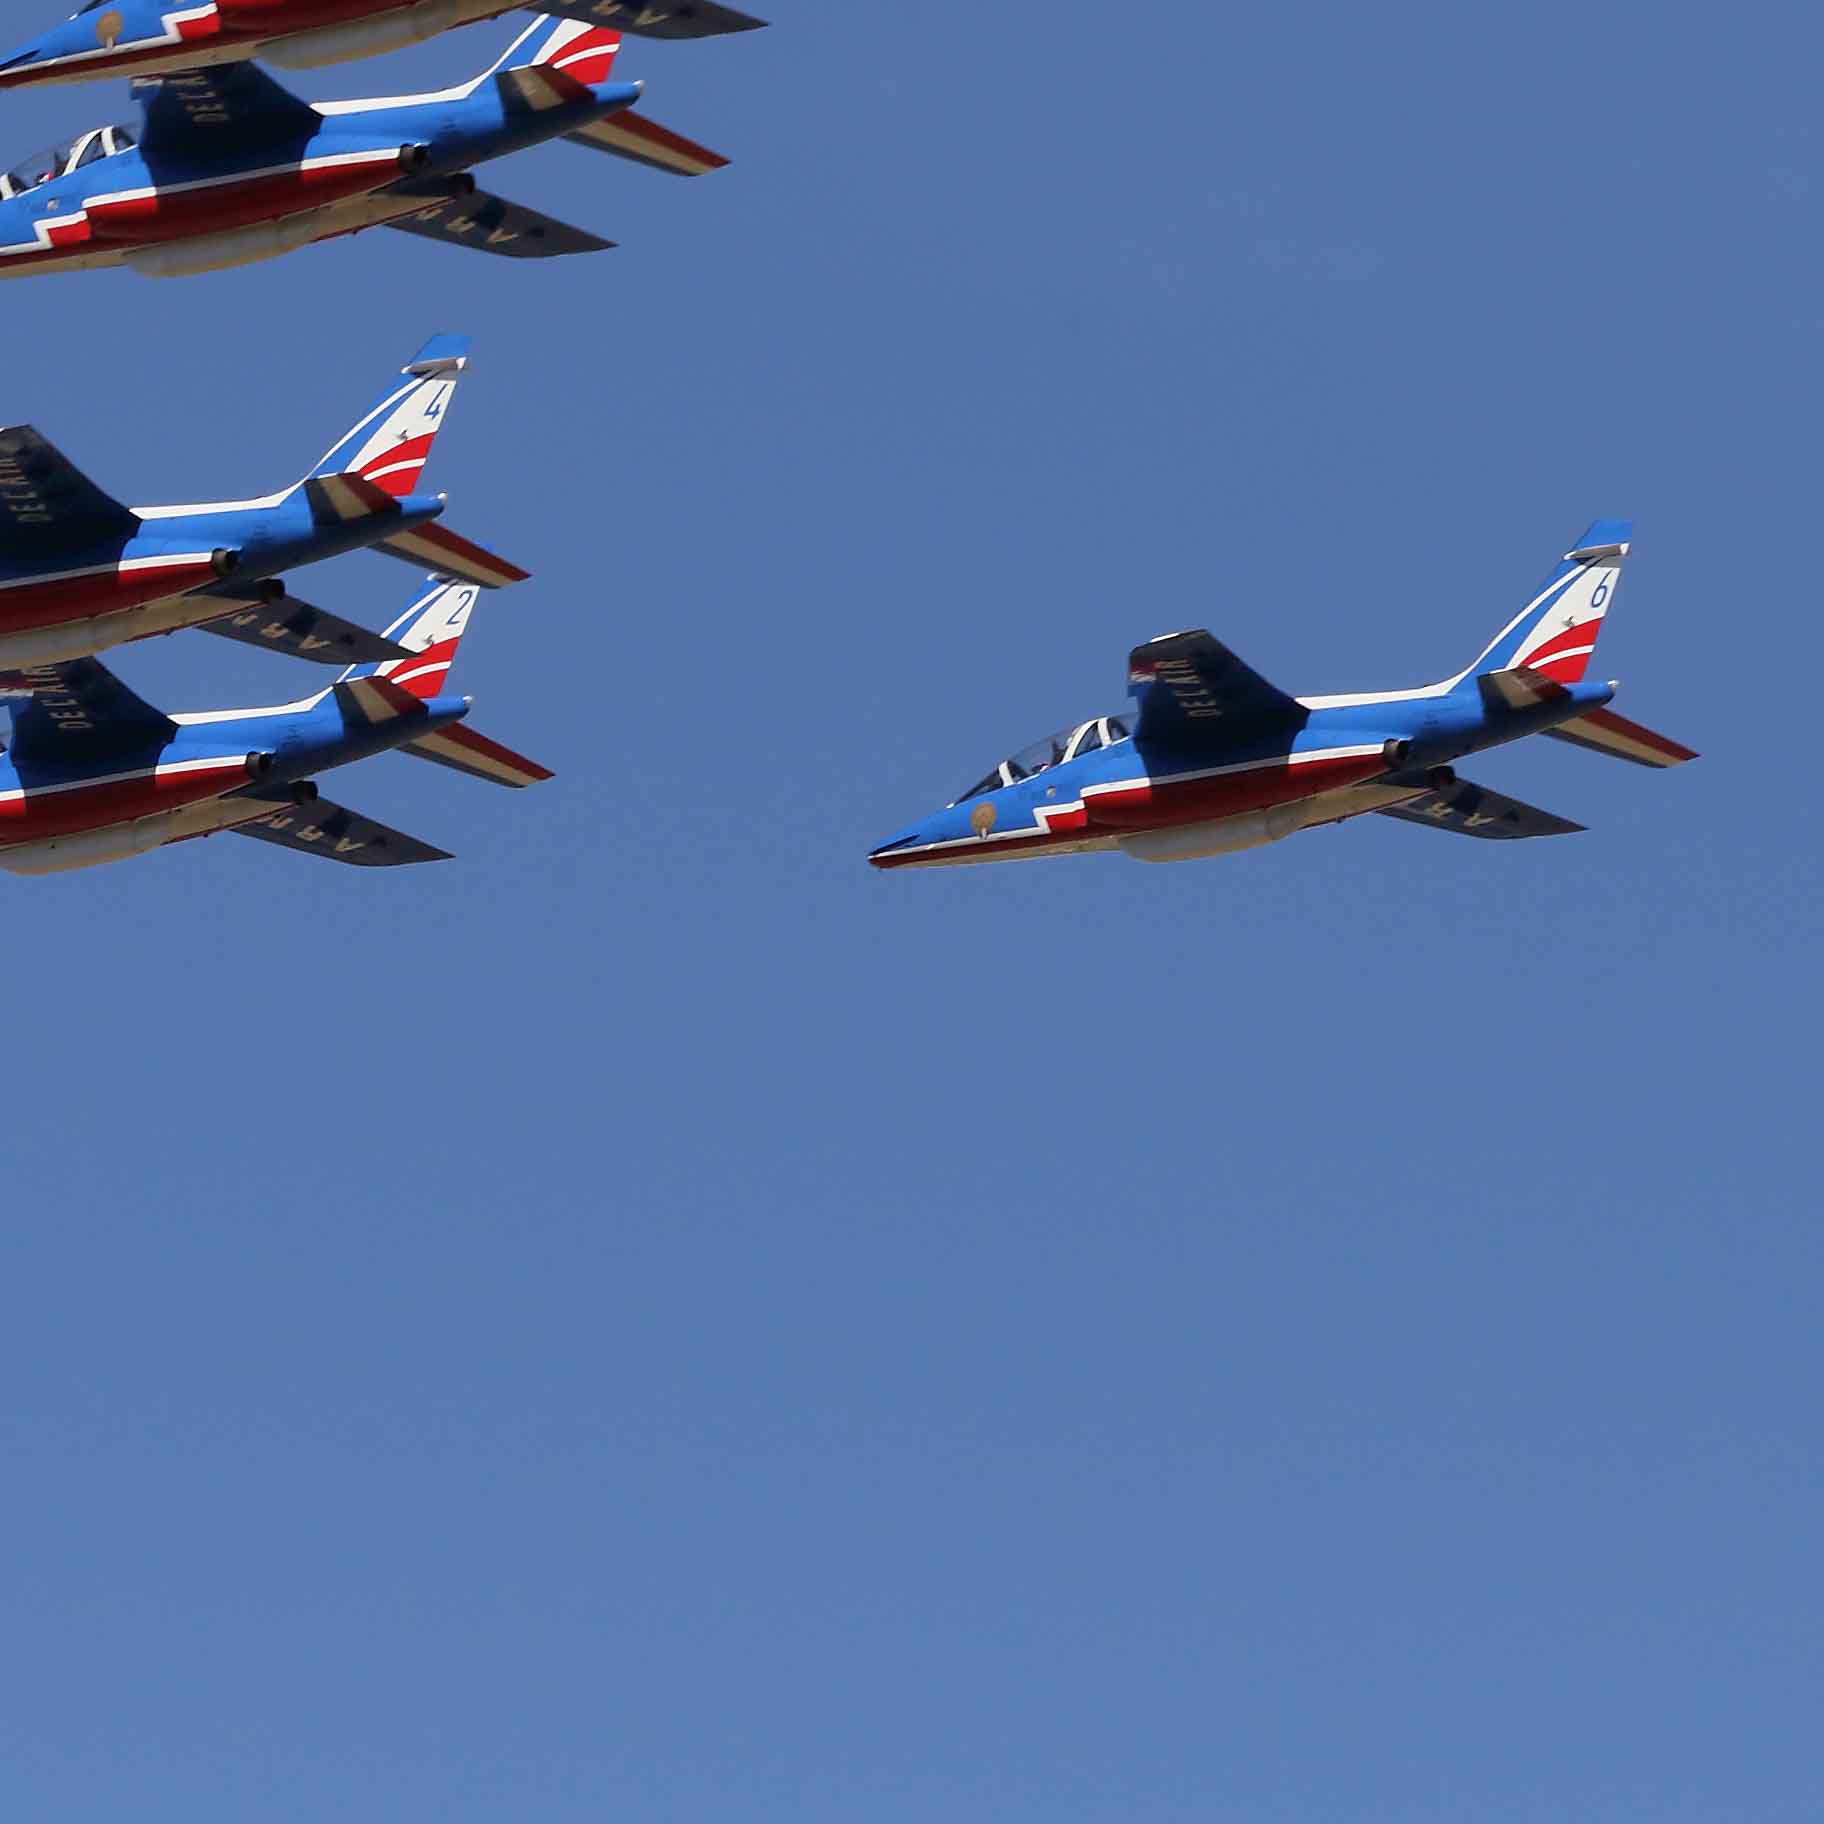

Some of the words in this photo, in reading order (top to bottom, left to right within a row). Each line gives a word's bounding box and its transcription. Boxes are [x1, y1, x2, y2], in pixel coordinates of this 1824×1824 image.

[423, 383, 448, 420] 4
[446, 589, 473, 626] 2
[1591, 570, 1612, 608] 6
